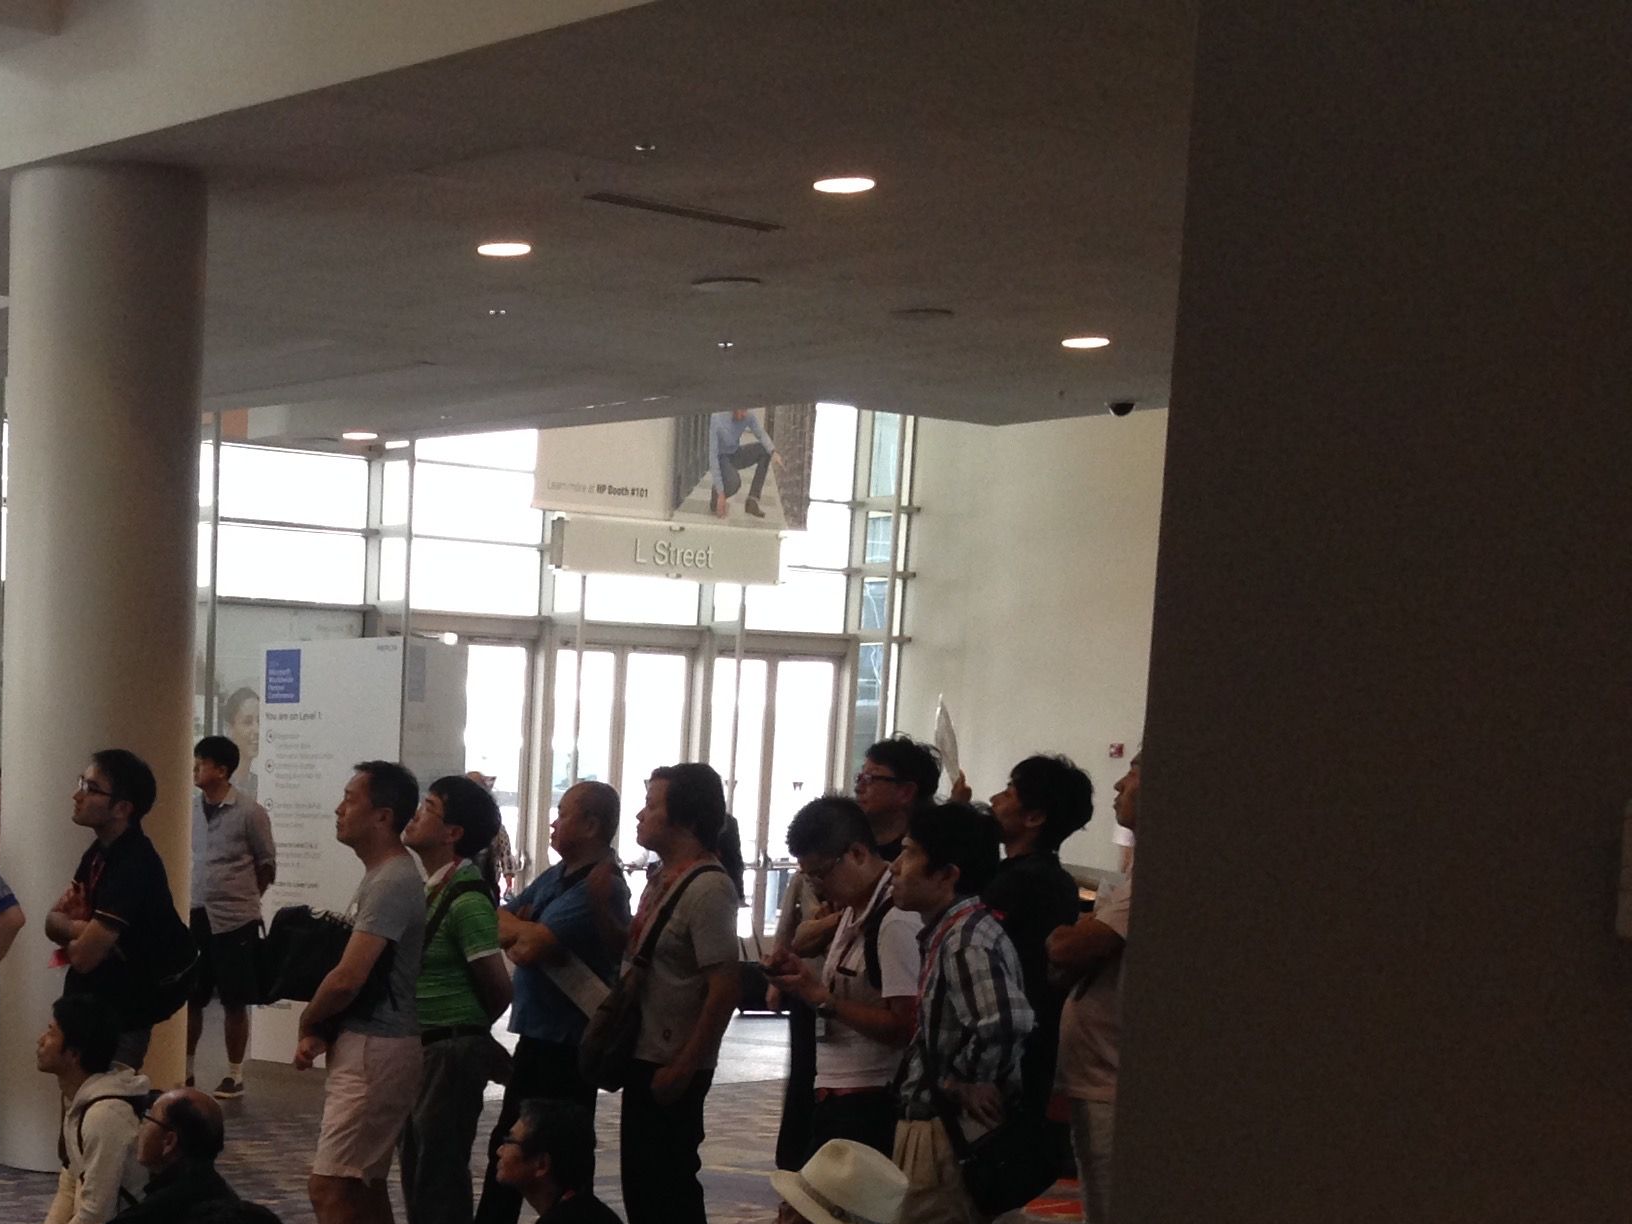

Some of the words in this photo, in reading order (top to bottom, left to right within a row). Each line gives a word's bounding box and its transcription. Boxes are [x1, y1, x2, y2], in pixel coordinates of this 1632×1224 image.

[596, 484, 606, 495] HP
[607, 485, 629, 497] Booth
[630, 487, 649, 498] #101
[634, 537, 647, 564] L
[653, 539, 714, 570] Street
